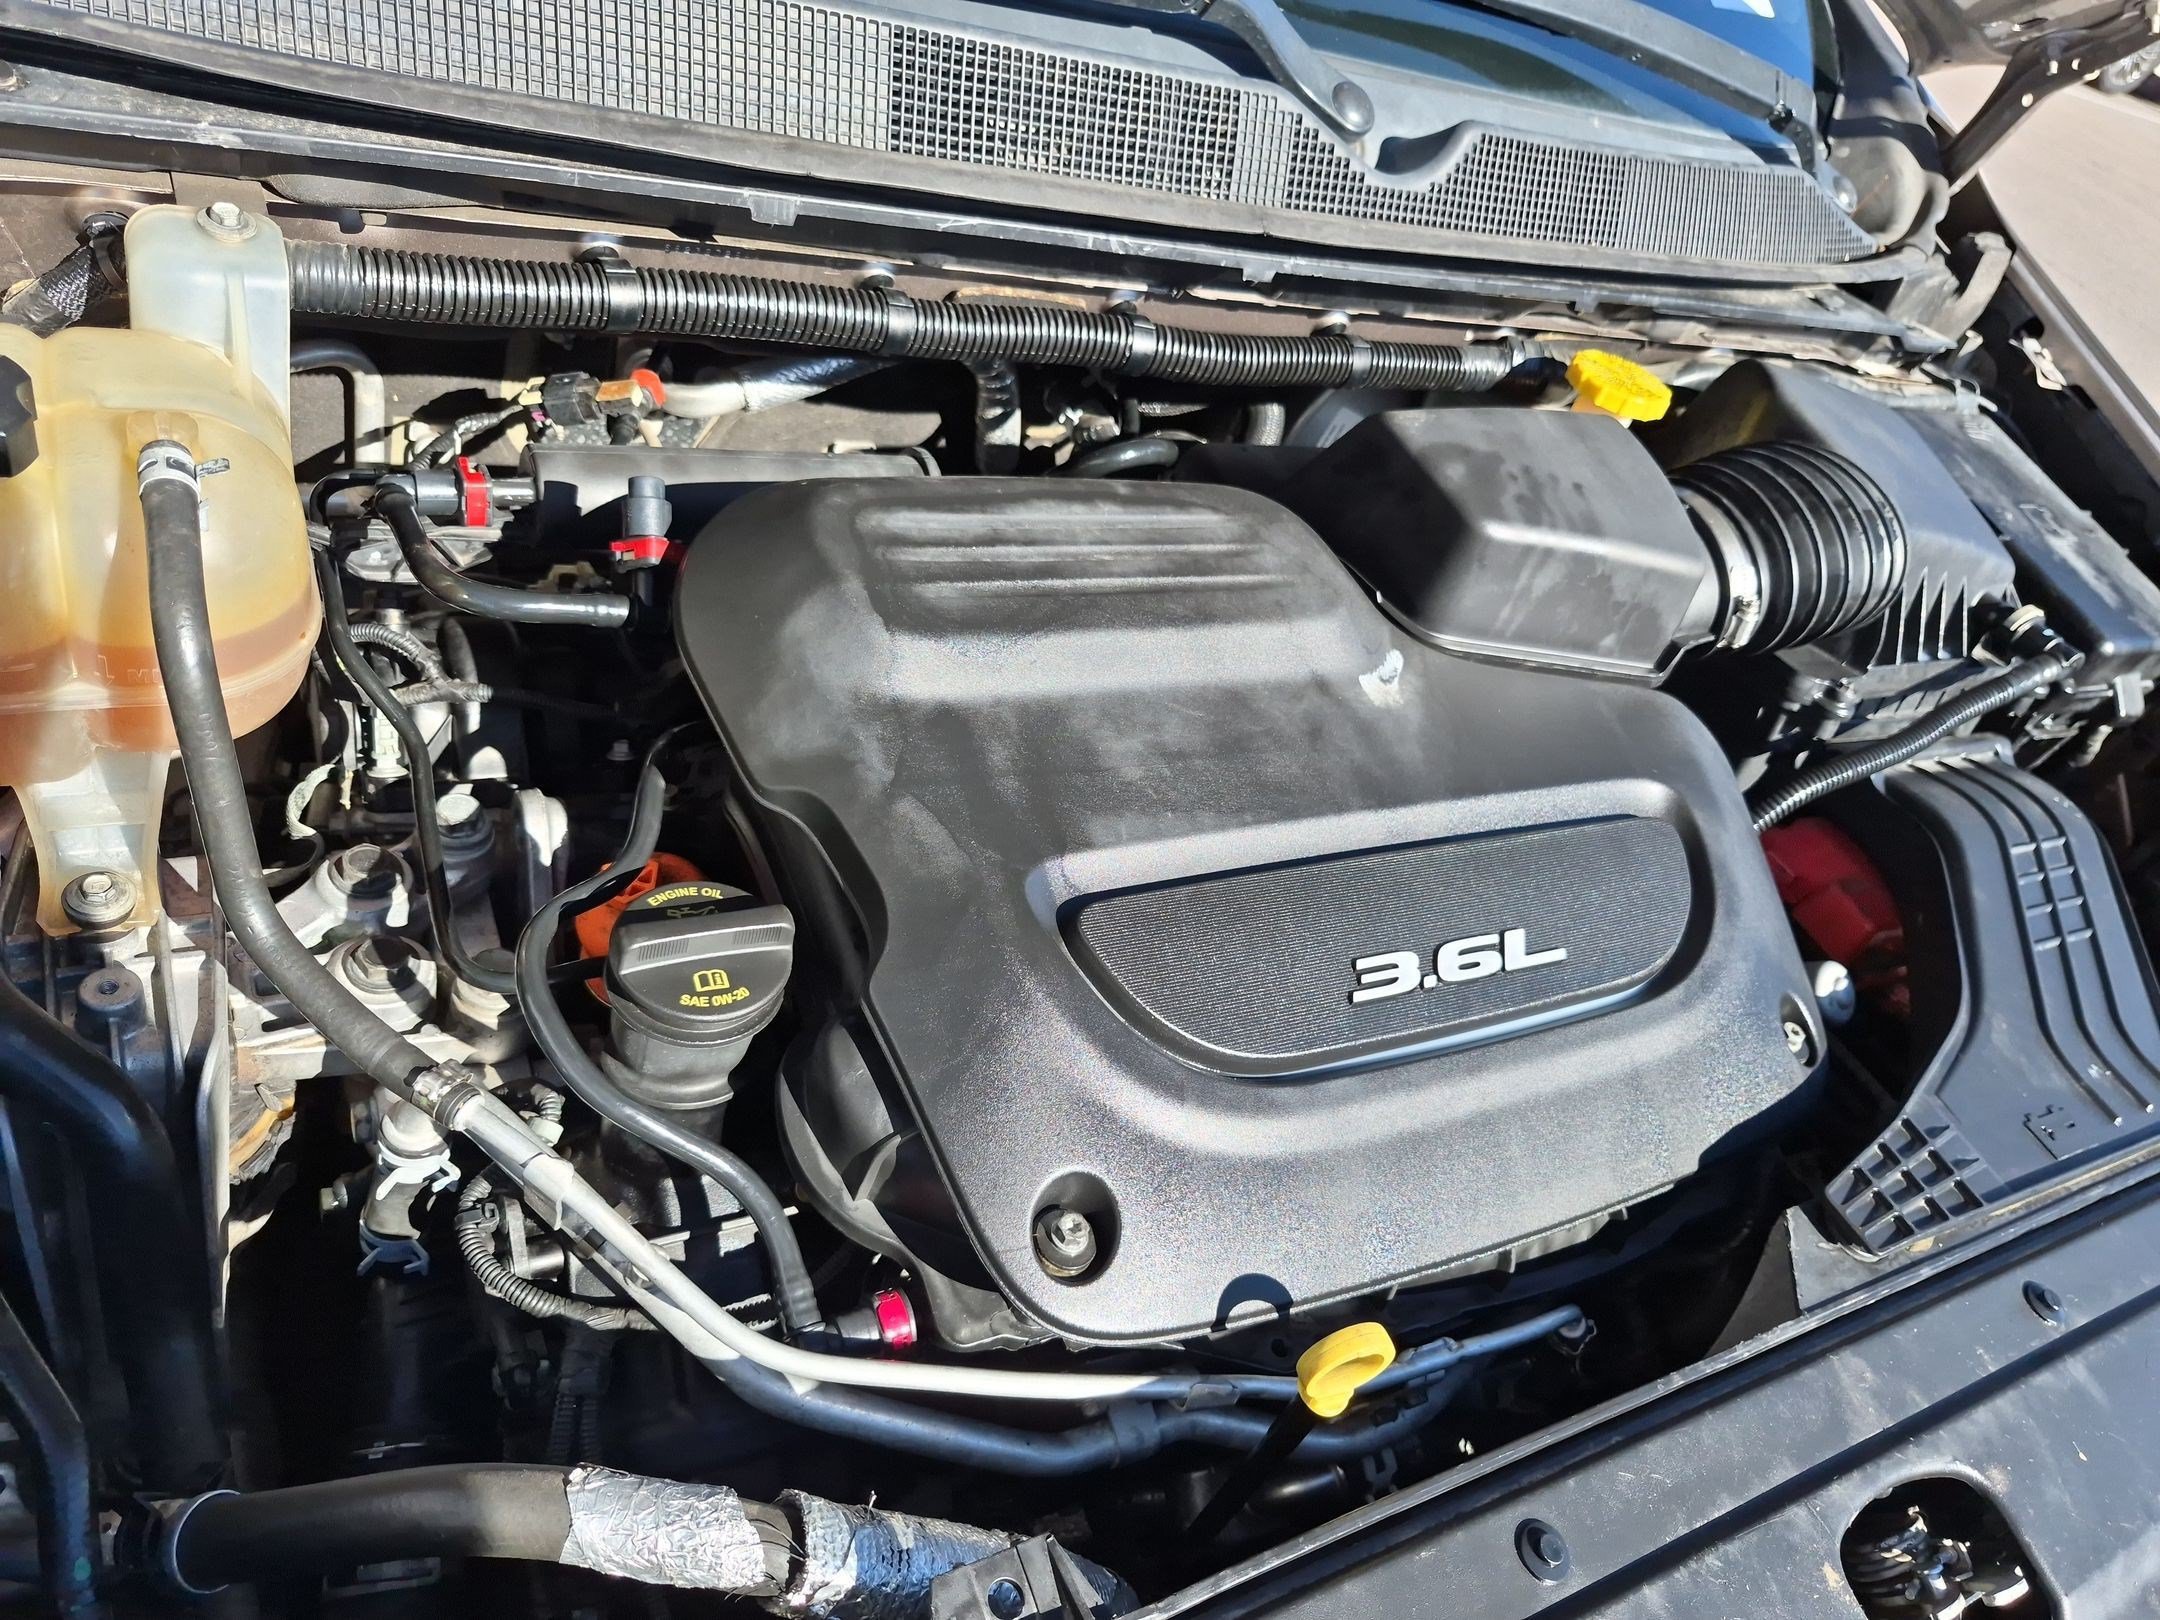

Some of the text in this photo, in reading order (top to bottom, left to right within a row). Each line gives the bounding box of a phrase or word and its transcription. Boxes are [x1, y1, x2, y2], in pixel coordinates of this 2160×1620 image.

[647, 887, 724, 906] ENGINE OIL
[1351, 928, 1568, 1003] 3.6L
[680, 987, 750, 1007] SAE 0W-20
